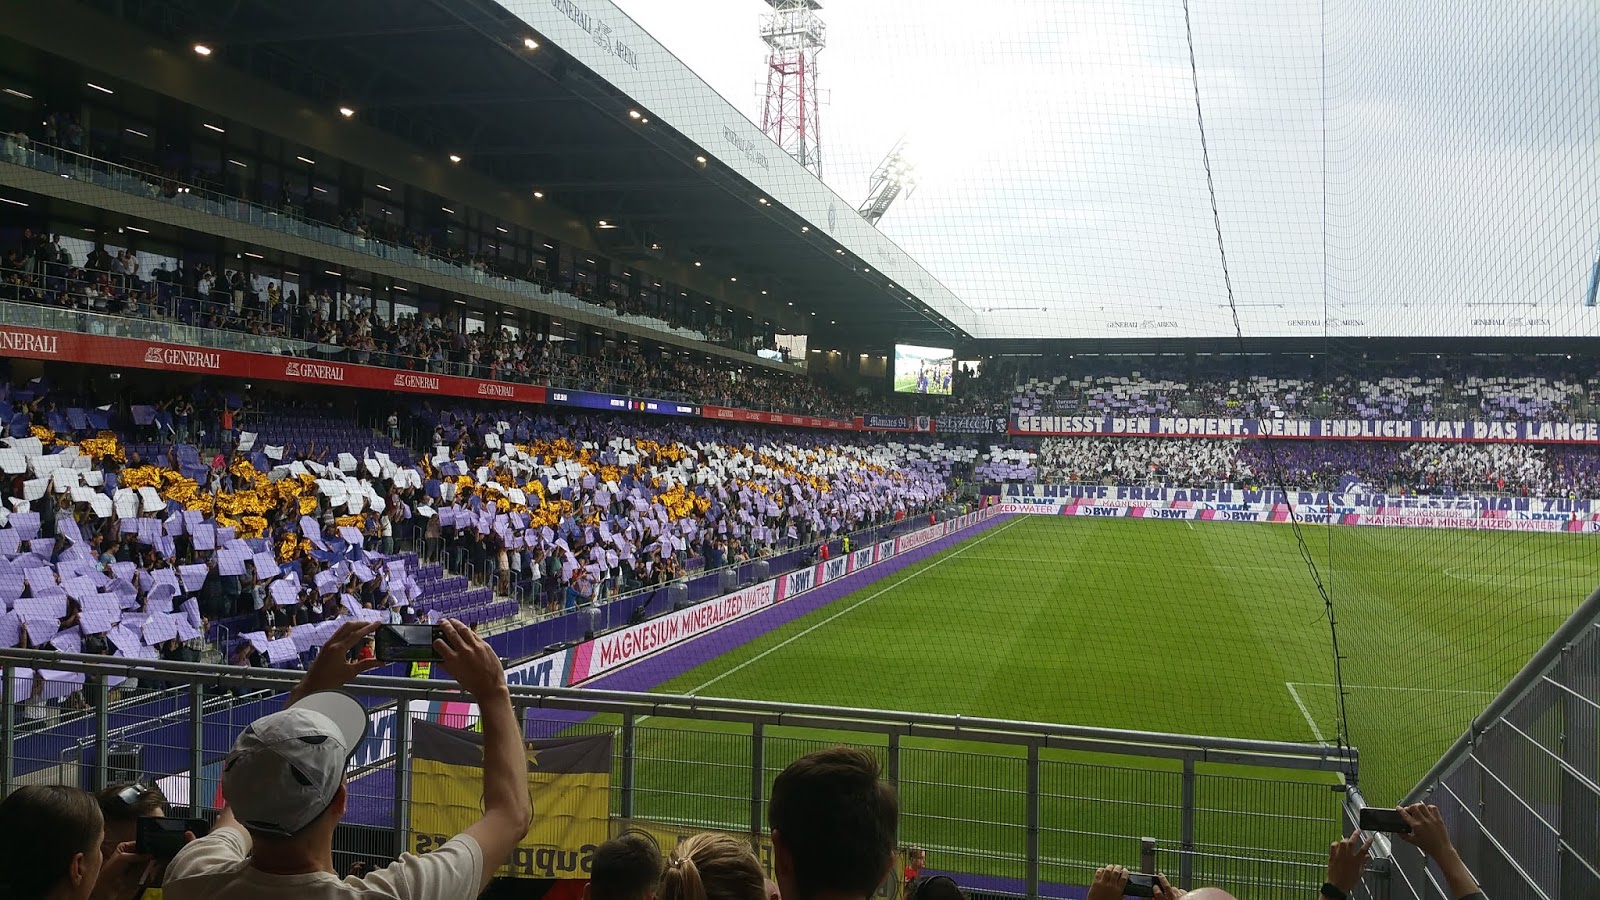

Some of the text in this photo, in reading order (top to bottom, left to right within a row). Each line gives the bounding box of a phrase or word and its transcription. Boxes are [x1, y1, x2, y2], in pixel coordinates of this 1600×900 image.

[614, 38, 638, 71] ARENA
[0, 331, 57, 354] NERALI
[164, 350, 221, 369] GENERALI
[300, 363, 344, 381] GENERALI
[404, 376, 439, 390] GENERALI
[486, 384, 514, 397] GENERALI
[869, 415, 897, 427] Maniacs
[1018, 416, 1598, 441] GENIESST DEN MOMENT, DENN ENDLICH HAT DAS LANGE
[1019, 505, 1053, 514] WATER
[1093, 507, 1118, 516] BWT
[1161, 510, 1187, 519] BWT
[1232, 512, 1259, 521] BWT
[1304, 514, 1331, 523] BWT
[1365, 516, 1555, 530] MAGNESIUM MINERALIZED WATER
[830, 559, 843, 578] BWT
[796, 571, 811, 592] BWT
[601, 585, 770, 668] MAGNESIUM MINERALIZED WATER
